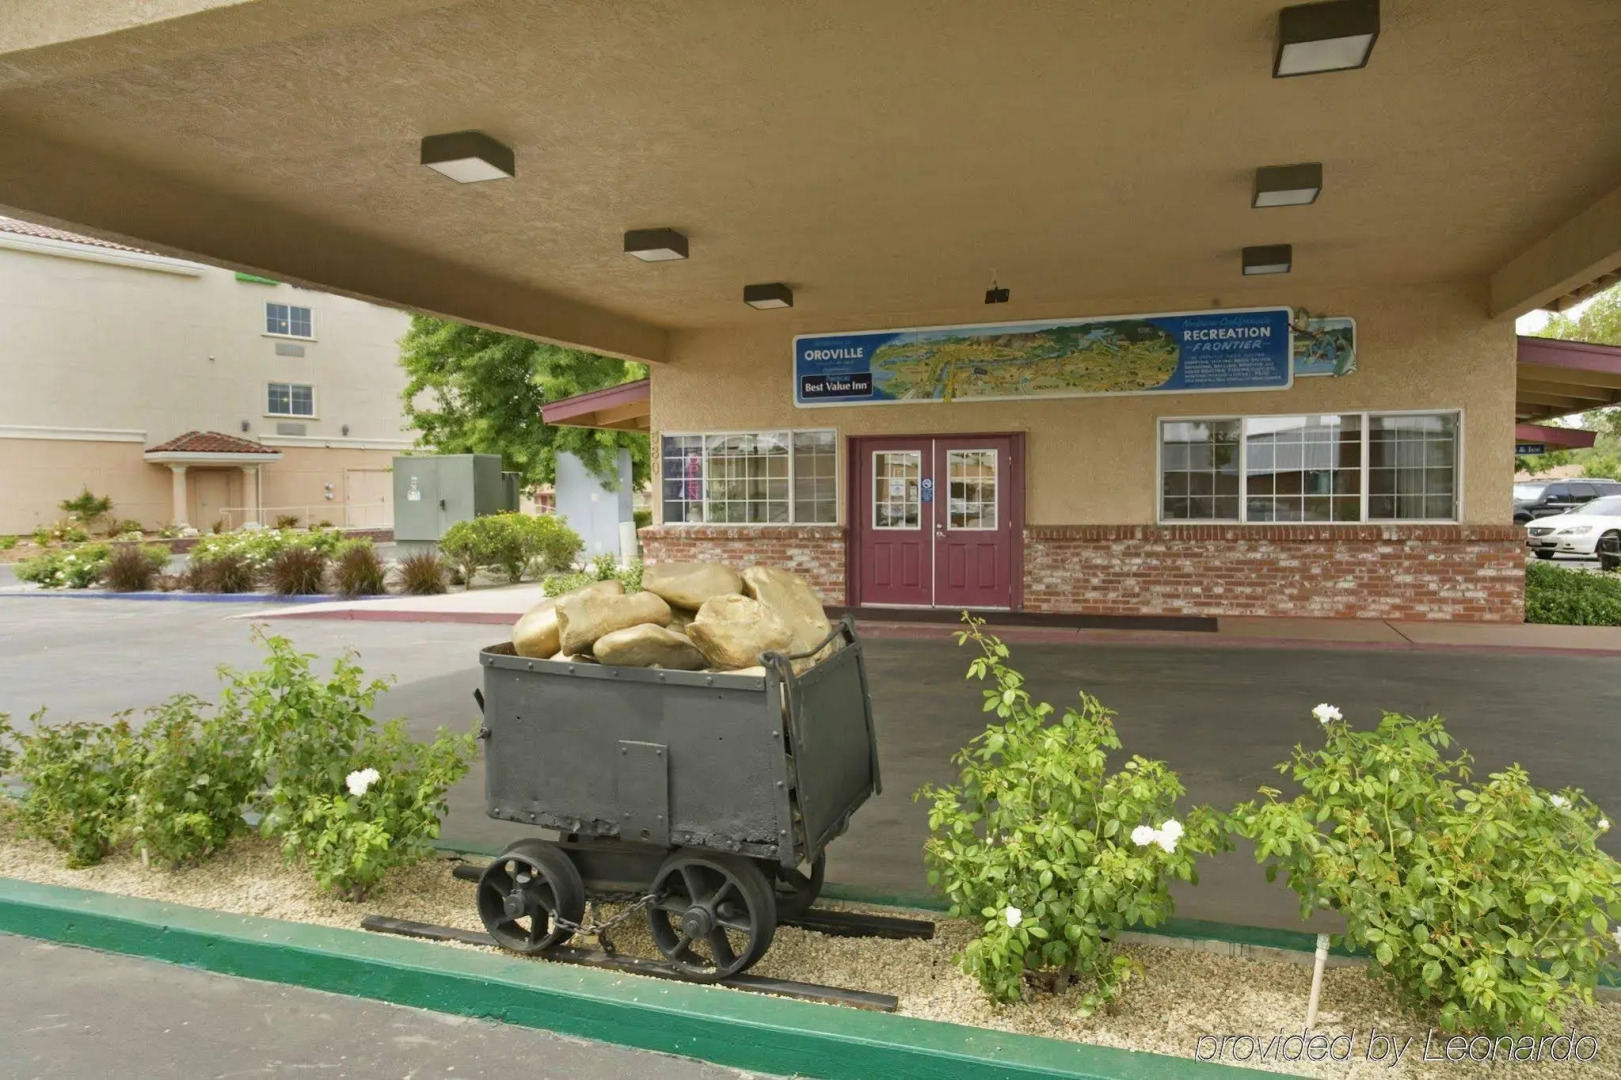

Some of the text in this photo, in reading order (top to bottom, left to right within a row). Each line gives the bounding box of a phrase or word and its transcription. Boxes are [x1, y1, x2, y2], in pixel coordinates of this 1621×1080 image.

[1183, 326, 1271, 341] RECREATION
[1192, 339, 1262, 352] FRONTIER
[804, 347, 864, 361] OROVILLE
[805, 381, 867, 392] Best Value Inn
